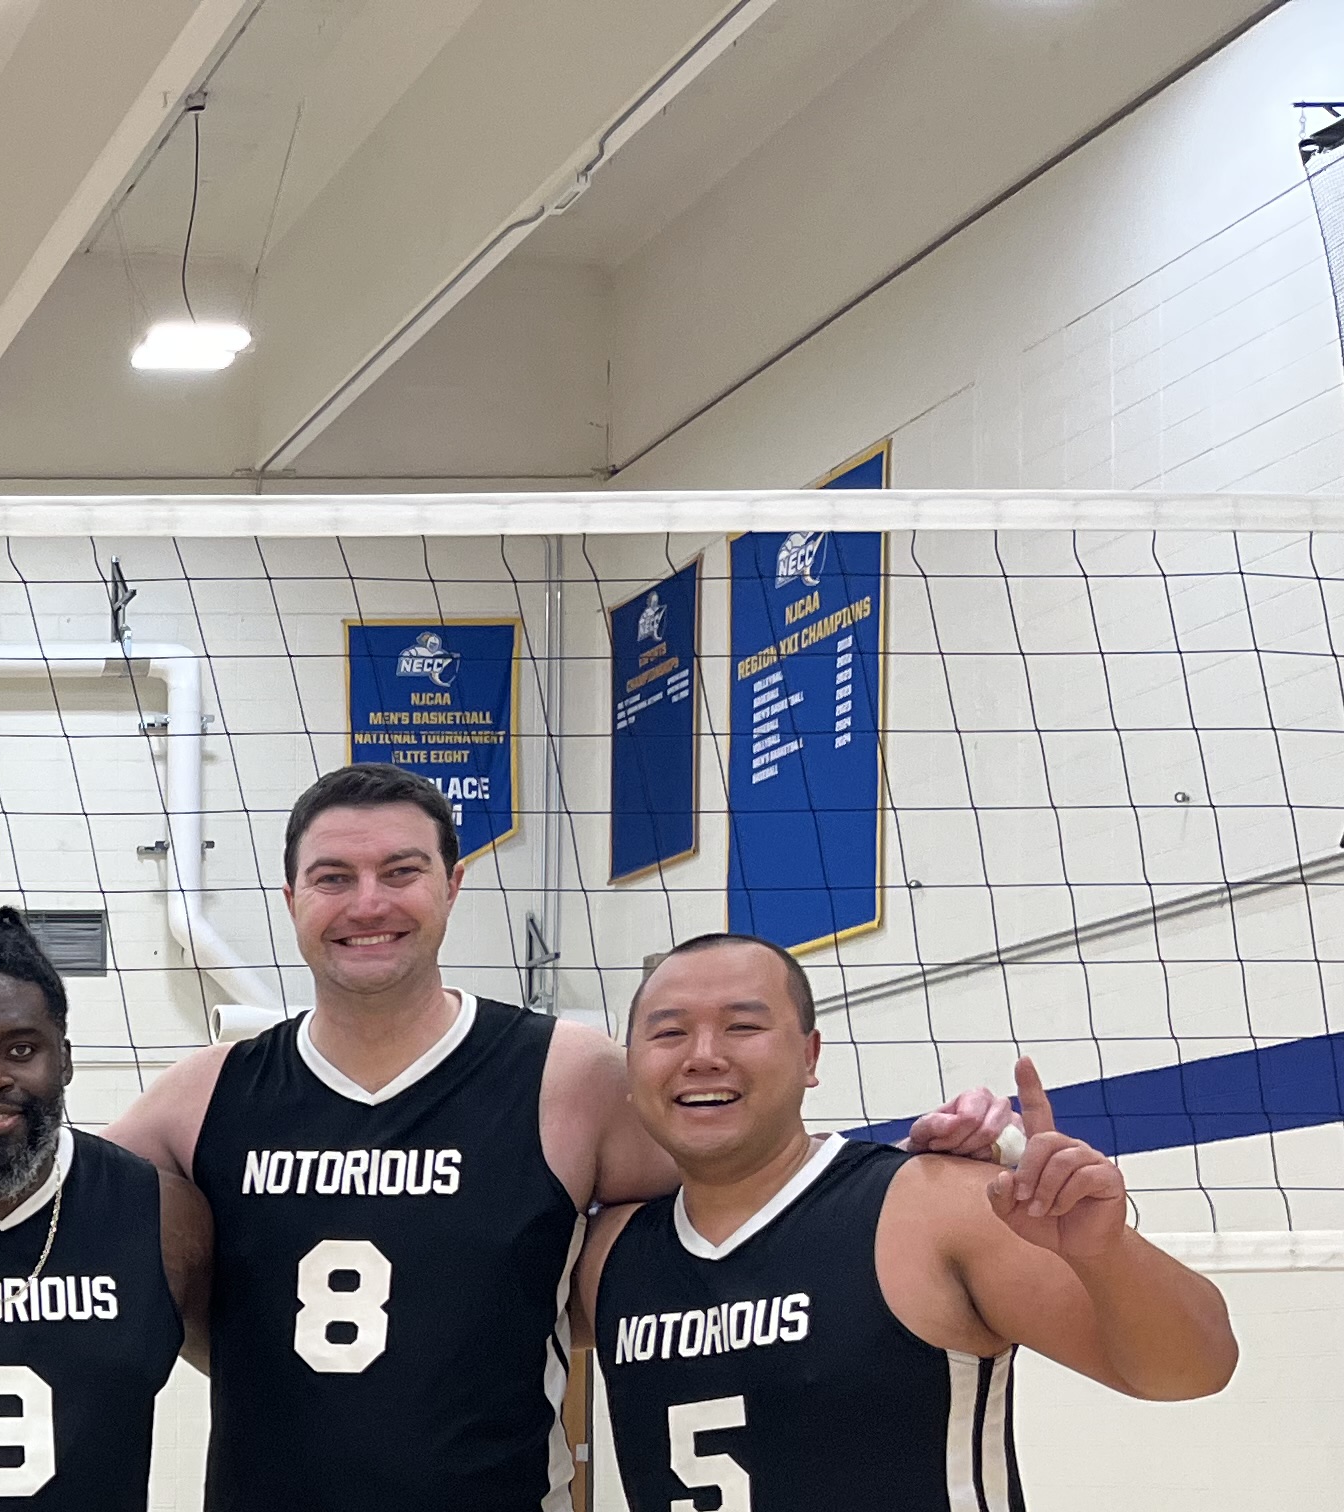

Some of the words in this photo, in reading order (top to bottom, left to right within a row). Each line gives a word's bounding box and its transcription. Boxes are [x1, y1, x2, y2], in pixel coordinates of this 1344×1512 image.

[778, 542, 815, 576] NECC
[784, 590, 821, 626] NJCAA
[737, 644, 778, 681] REGION
[779, 632, 800, 660] XXI
[801, 595, 872, 649] CHAMPIONS
[400, 658, 443, 673] NECC
[410, 692, 452, 706] NJCAA
[369, 711, 410, 725] MEN'S
[412, 711, 494, 725] BASKETBALL
[354, 730, 418, 745] NATIONAL
[419, 730, 506, 745] TOURNAMENT
[392, 750, 428, 764] ELITE
[430, 750, 471, 764] EIGHT
[240, 1148, 463, 1196] NOTORIOUS
[292, 1238, 393, 1374] 8
[615, 1292, 811, 1365] NOTORIOUS
